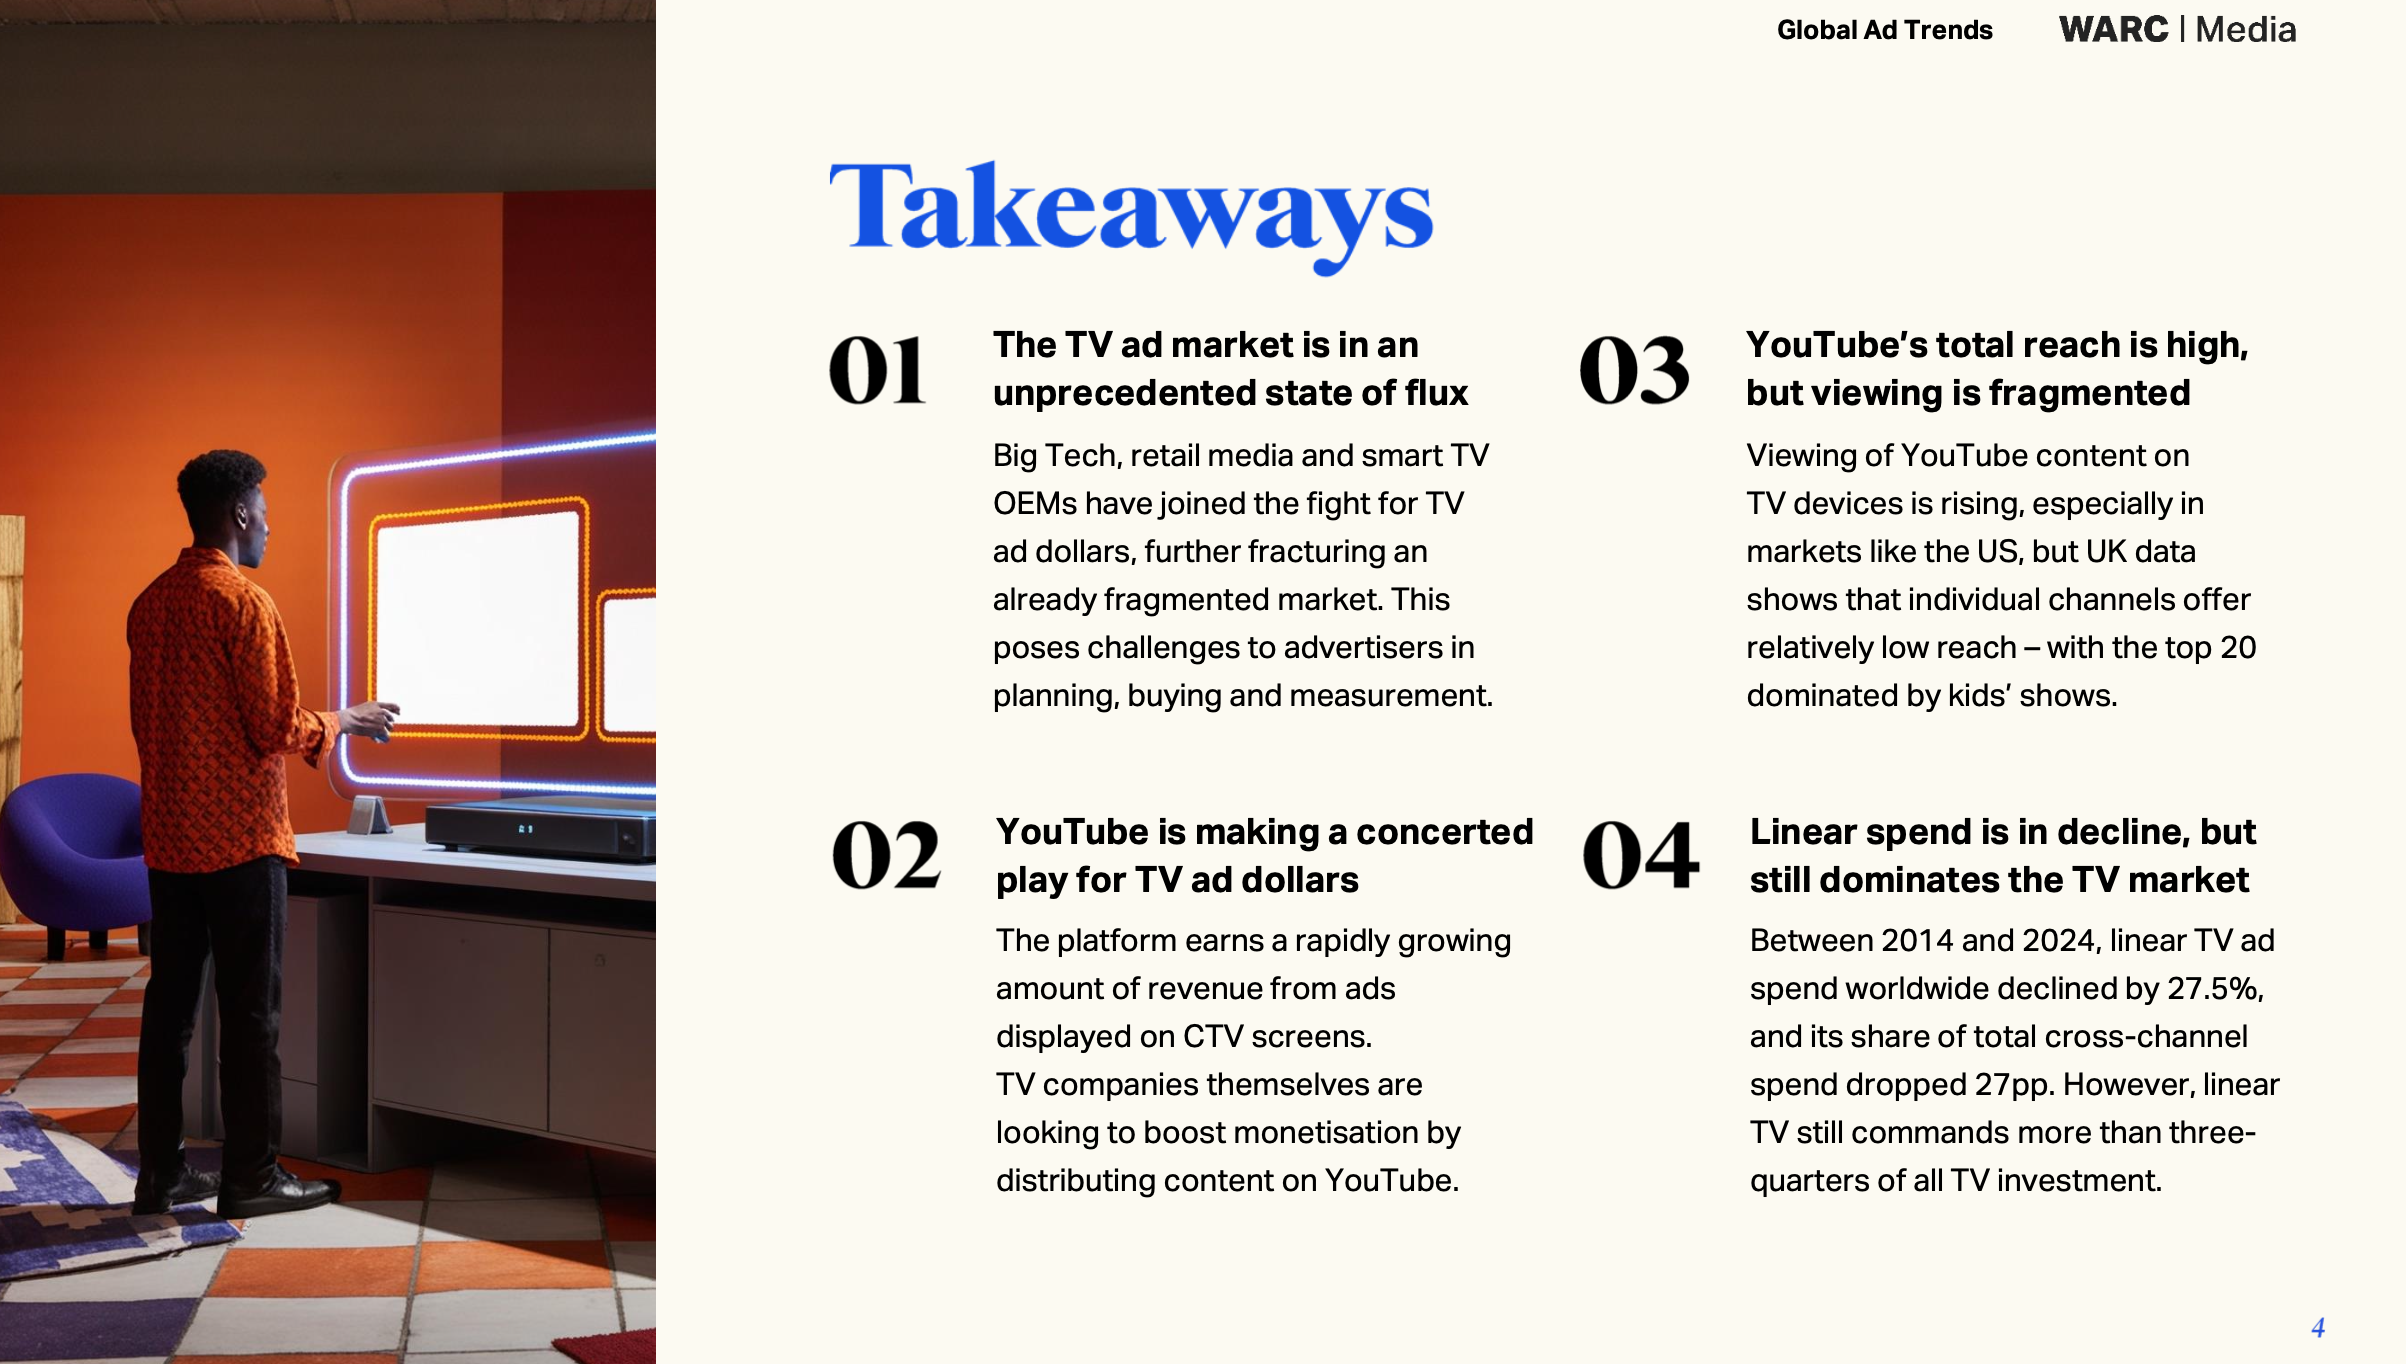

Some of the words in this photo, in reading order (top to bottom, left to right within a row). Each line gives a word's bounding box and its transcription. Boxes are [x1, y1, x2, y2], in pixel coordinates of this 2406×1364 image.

[1778, 19, 1857, 40] Global
[1863, 19, 1897, 40] Ad
[1904, 19, 1993, 40] Trends
[2059, 15, 2169, 42] WARC
[2197, 16, 2296, 42] Media
[830, 160, 1433, 277] Takeaways
[993, 331, 1056, 358] The
[1065, 331, 1113, 357] TV
[1122, 331, 1162, 358] ad
[1173, 331, 1294, 358] market
[1304, 331, 1330, 358] is
[1340, 331, 1368, 357] in
[1378, 337, 1418, 358] an
[1936, 331, 2013, 358] total
[2025, 331, 2120, 358] reach
[2131, 331, 2158, 358] is
[2168, 331, 2248, 365] high,
[829, 336, 926, 405] 01
[1580, 336, 1689, 405] 03
[995, 379, 1256, 412] unprecedented
[1266, 381, 1352, 406] state
[1362, 378, 1397, 406] of
[1405, 378, 1469, 406] flux
[1748, 379, 1804, 406] but
[1811, 379, 1942, 413] viewing
[1954, 379, 1981, 406] is
[1989, 378, 2190, 413] fragmented
[995, 443, 1036, 473] Big
[1045, 443, 1122, 469] Tech,
[1132, 443, 1199, 467] retail
[1209, 443, 1293, 467] media
[1302, 443, 1353, 467] and
[1362, 445, 1443, 467] smart
[1451, 443, 1490, 466] TV
[1747, 443, 1856, 473] Viewing
[1866, 443, 1895, 467] of
[1901, 443, 2028, 467] YouTube
[2037, 445, 2147, 467] content
[2155, 449, 2189, 467] on
[994, 491, 1077, 515] OEMs
[1087, 491, 1152, 515] have
[1157, 491, 1245, 520] joined
[1254, 491, 1299, 515] the
[1307, 491, 1371, 521] fight
[1378, 491, 1418, 515] for
[1426, 491, 1465, 514] TV
[1747, 491, 1786, 514] TV
[1794, 491, 1903, 515] devices
[1912, 491, 1933, 515] is
[1942, 491, 2024, 521] rising,
[2033, 491, 2173, 520] especially
[2182, 491, 2203, 514] in
[1747, 587, 1837, 611] shows
[1846, 587, 1901, 611] that
[1910, 587, 2039, 611] individual
[2049, 587, 2175, 611] channels
[2184, 587, 2251, 611] offer
[995, 641, 1079, 664] poses
[1088, 635, 1240, 665] challenges
[1248, 637, 1276, 659] to
[1285, 635, 1443, 659] advertisers
[1452, 635, 1474, 658] in
[1748, 635, 1874, 664] relatively
[1883, 635, 1929, 659] low
[1938, 635, 2016, 659] reach
[2047, 635, 2103, 659] with
[2112, 635, 2157, 659] the
[2165, 637, 2211, 664] top
[2221, 635, 2256, 659] 20
[995, 683, 1119, 713] planning,
[1129, 683, 1221, 713] buying
[1230, 683, 1281, 707] and
[1291, 685, 1492, 707] measurement.
[1748, 683, 1897, 707] dominated
[1908, 683, 1941, 712] by
[2020, 683, 2117, 707] shows.
[996, 818, 1148, 845] YouTube
[1160, 818, 1186, 845] is
[1197, 818, 1319, 852] making
[1329, 824, 1347, 845] a
[1357, 818, 1533, 845] concerted
[1752, 818, 1858, 845] Linear
[1867, 818, 1971, 851] spend
[1983, 818, 2009, 845] is
[2020, 818, 2047, 844] in
[2058, 818, 2190, 848] decline,
[2202, 818, 2257, 845] but
[833, 821, 941, 889] 02
[1583, 821, 1700, 889] 04
[998, 866, 1068, 899] play
[1076, 865, 1127, 893] for
[1135, 866, 1183, 892] TV
[1192, 866, 1232, 893] ad
[1242, 866, 1359, 893] dollars
[1751, 866, 1810, 893] still
[1820, 866, 2000, 893] dominates
[2008, 866, 2063, 893] the
[2072, 866, 2120, 892] TV
[2130, 866, 2250, 893] market
[996, 928, 1049, 952] The
[1059, 928, 1176, 957] platform
[1186, 934, 1264, 952] earns
[1272, 934, 1287, 952] a
[1297, 928, 1390, 957] rapidly
[1399, 928, 1510, 958] growing
[1752, 928, 1873, 952] Between
[1882, 928, 1953, 952] 2014
[1963, 928, 2013, 952] and
[2023, 928, 2101, 954] 2024,
[2112, 928, 2187, 952] linear
[2194, 928, 2234, 951] TV
[2241, 928, 2274, 952] ad
[1751, 976, 1837, 1005] spend
[1845, 976, 1989, 1000] worldwide
[1998, 976, 2117, 1000] declined
[2127, 976, 2160, 1005] by
[2168, 976, 2263, 1002] 27.5%,
[997, 1024, 1130, 1053] displayed
[1141, 1030, 1174, 1048] on
[1184, 1024, 1244, 1048] CTV
[1252, 1030, 1371, 1048] screens.
[1751, 1072, 1837, 1101] spend
[1847, 1072, 1966, 1101] dropped
[1976, 1072, 2054, 1101] 27pp.
[2065, 1072, 2195, 1098] However,
[2205, 1072, 2280, 1096] linear
[998, 1120, 1098, 1150] looking
[1107, 1122, 1135, 1144] to
[1145, 1120, 1226, 1144] boost
[1235, 1120, 1418, 1144] monetisation
[1428, 1120, 1461, 1149] by
[1750, 1120, 1789, 1143] TV
[1797, 1120, 1842, 1144] still
[1852, 1120, 2009, 1144] commands
[2019, 1126, 2091, 1144] more
[2100, 1120, 2161, 1144] than
[2169, 1120, 2256, 1144] three-
[997, 1168, 1155, 1198] distributing
[1165, 1170, 1274, 1192] content
[1283, 1174, 1316, 1192] on
[1325, 1168, 1458, 1192] YouTube.
[1751, 1170, 1869, 1197] quarters
[1878, 1168, 1907, 1192] of
[1914, 1168, 1942, 1192] all
[1951, 1168, 1990, 1191] TV
[1999, 1168, 2161, 1192] investment.
[2311, 1317, 2325, 1338] 4
